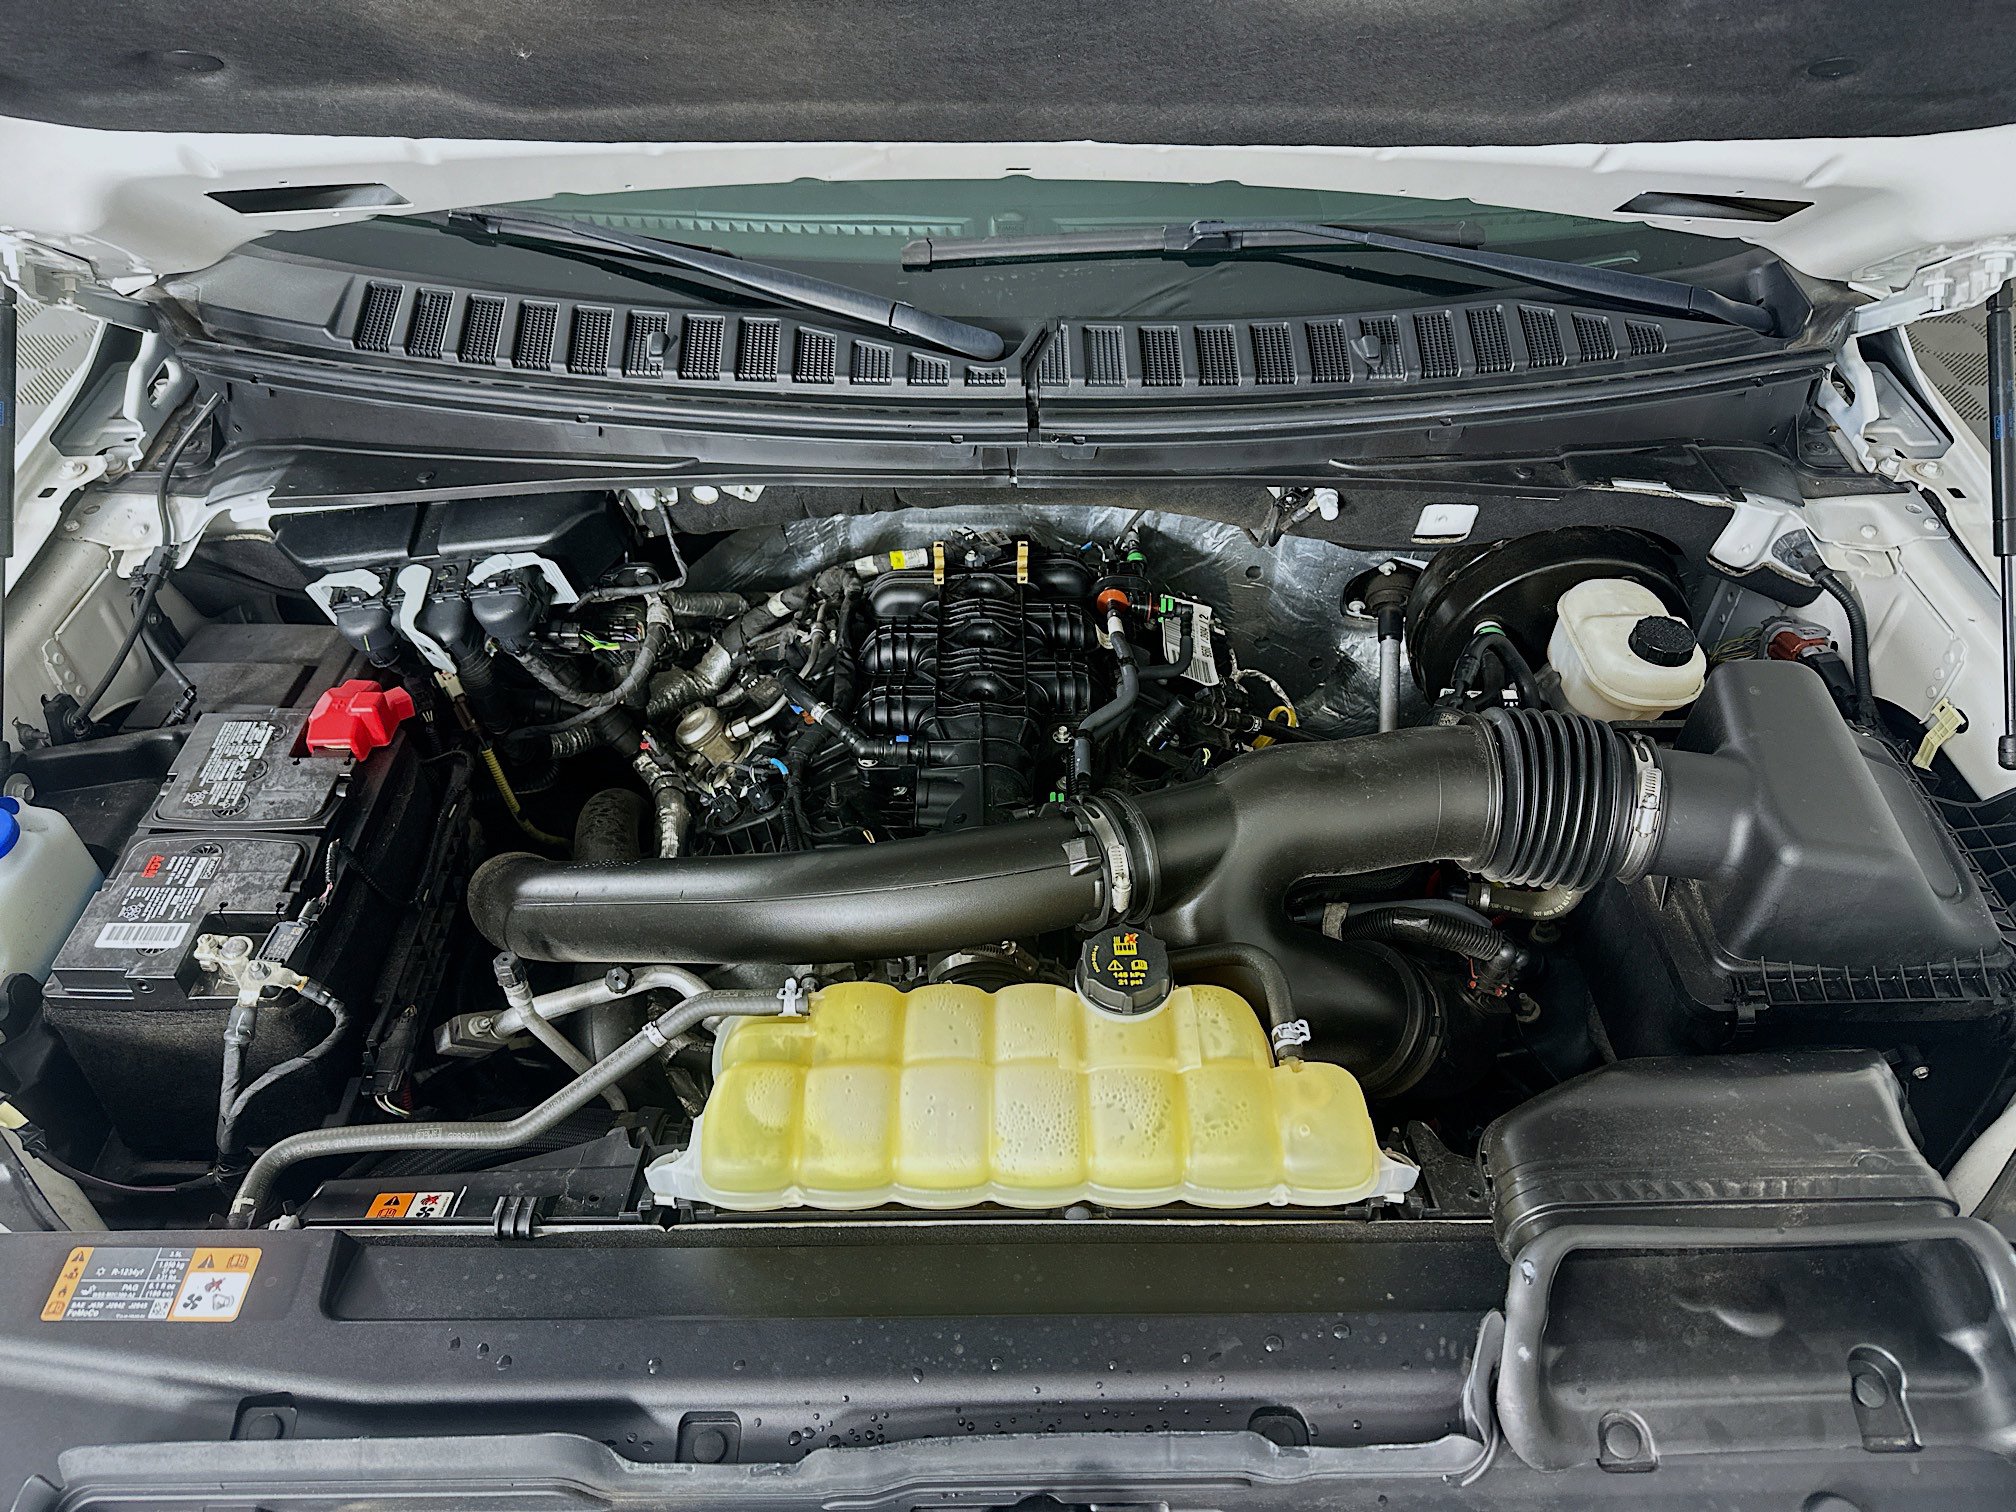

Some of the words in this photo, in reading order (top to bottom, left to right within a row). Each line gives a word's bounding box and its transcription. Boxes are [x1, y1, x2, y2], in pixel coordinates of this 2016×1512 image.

[145, 855, 165, 878] AGM
[111, 1268, 145, 1277] R-1234yf
[66, 1309, 99, 1317] FoMoCo
